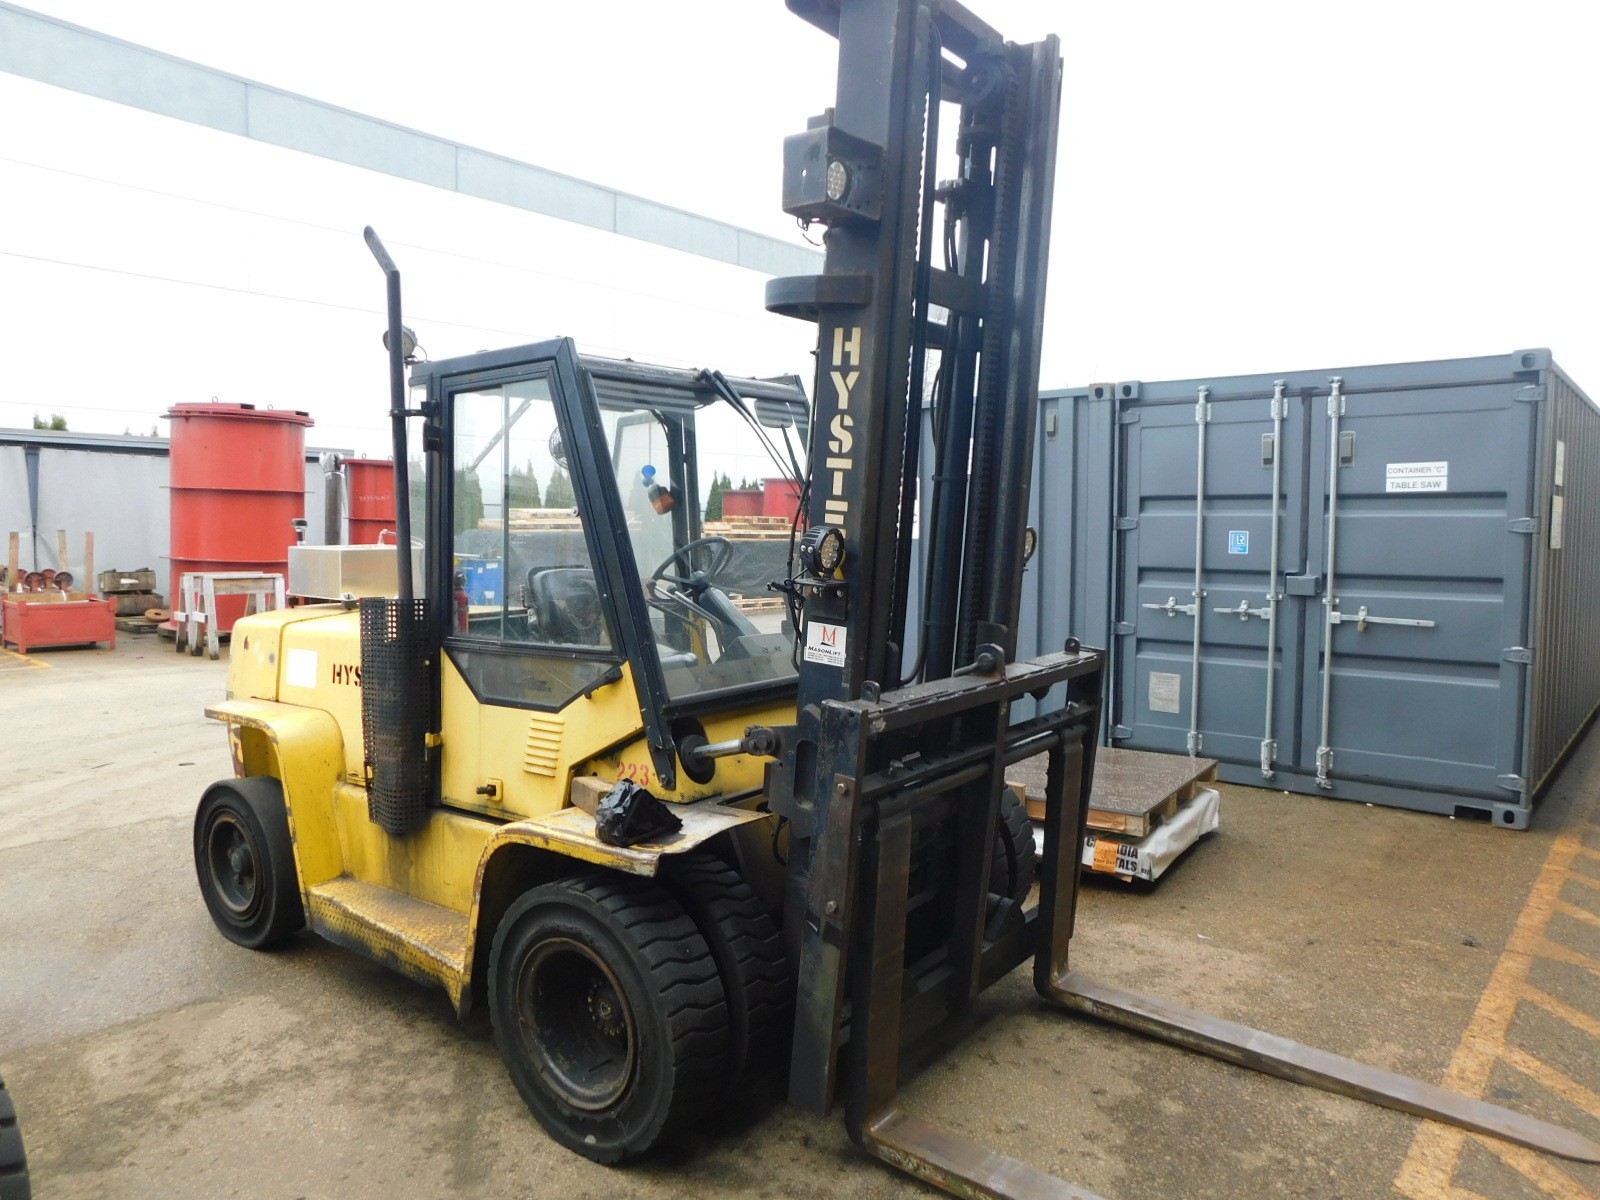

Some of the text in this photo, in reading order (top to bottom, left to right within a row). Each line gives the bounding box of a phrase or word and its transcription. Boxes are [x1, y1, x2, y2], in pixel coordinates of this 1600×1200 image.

[825, 327, 862, 580] HYSTE
[1388, 466, 1432, 474] CONTAINER
[1390, 480, 1442, 489] TABLE SAW
[332, 664, 362, 687] HYS
[617, 761, 649, 786] 223
